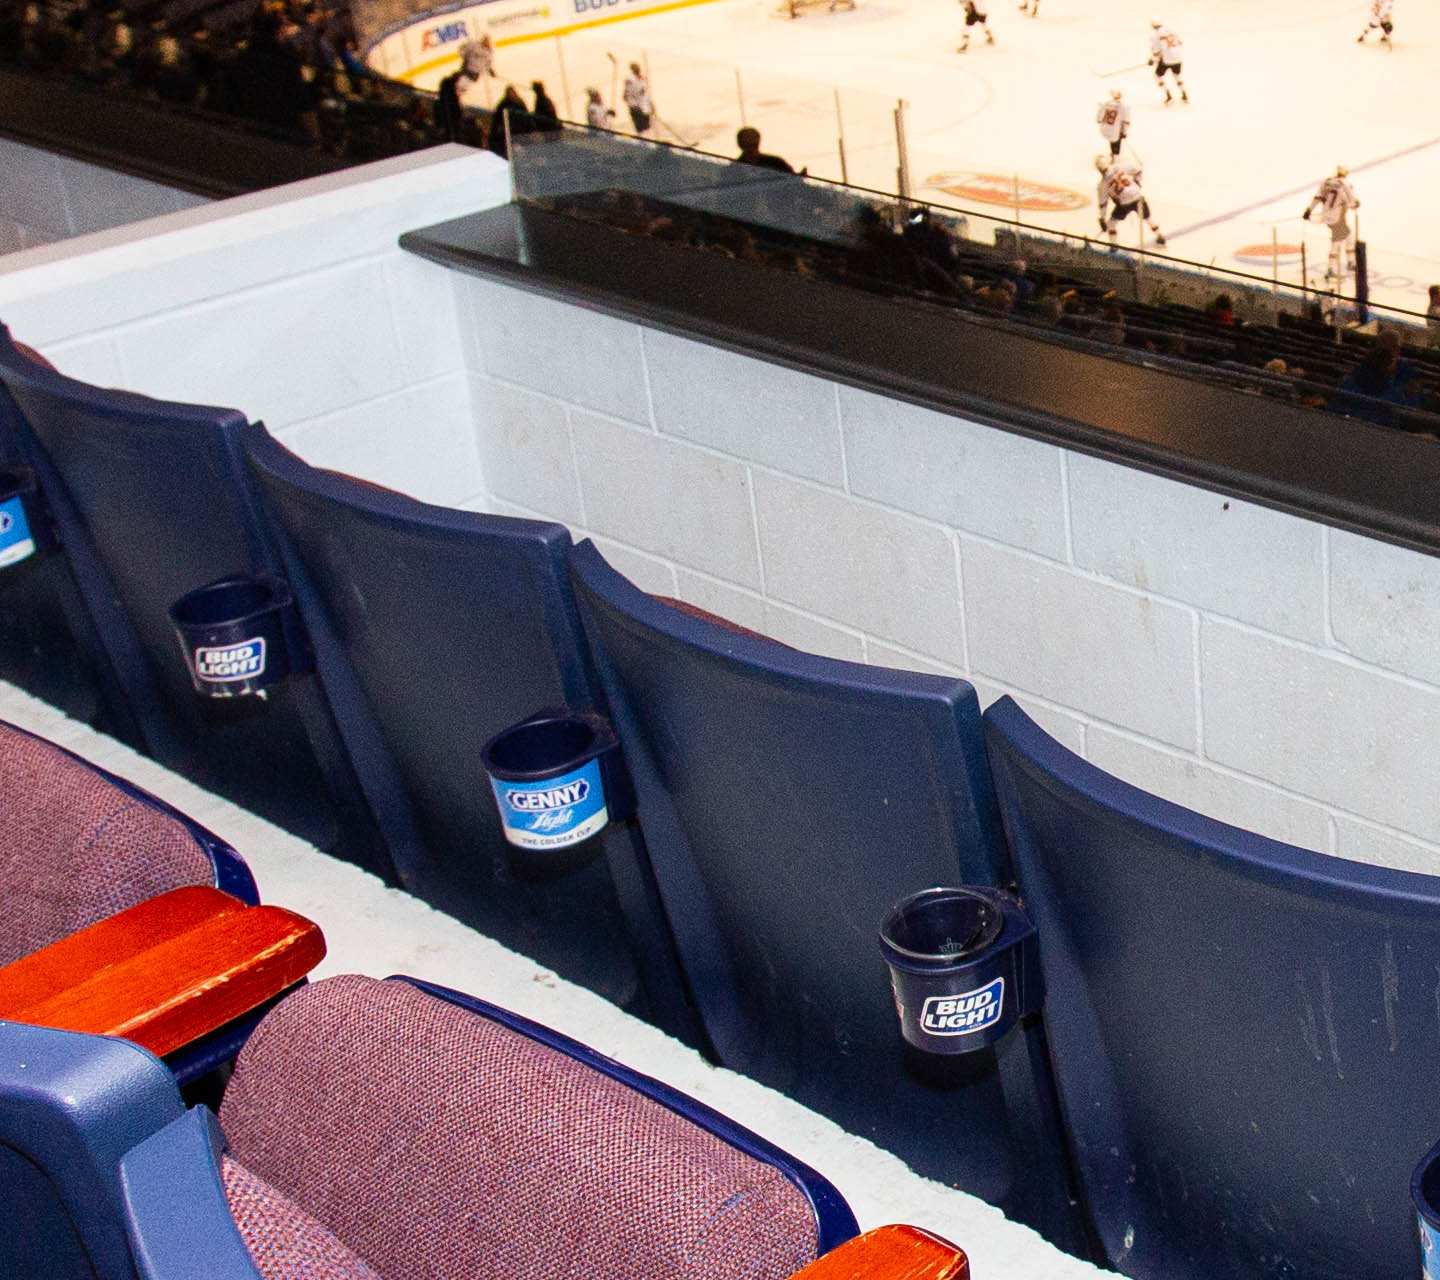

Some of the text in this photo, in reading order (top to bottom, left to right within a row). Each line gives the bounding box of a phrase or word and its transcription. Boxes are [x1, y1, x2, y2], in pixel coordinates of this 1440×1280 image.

[200, 654, 260, 675] LIGHT
[205, 646, 254, 664] BUD
[512, 782, 581, 809] GENNY
[924, 1000, 999, 1029] LIGHT
[935, 990, 993, 1015] BUD
